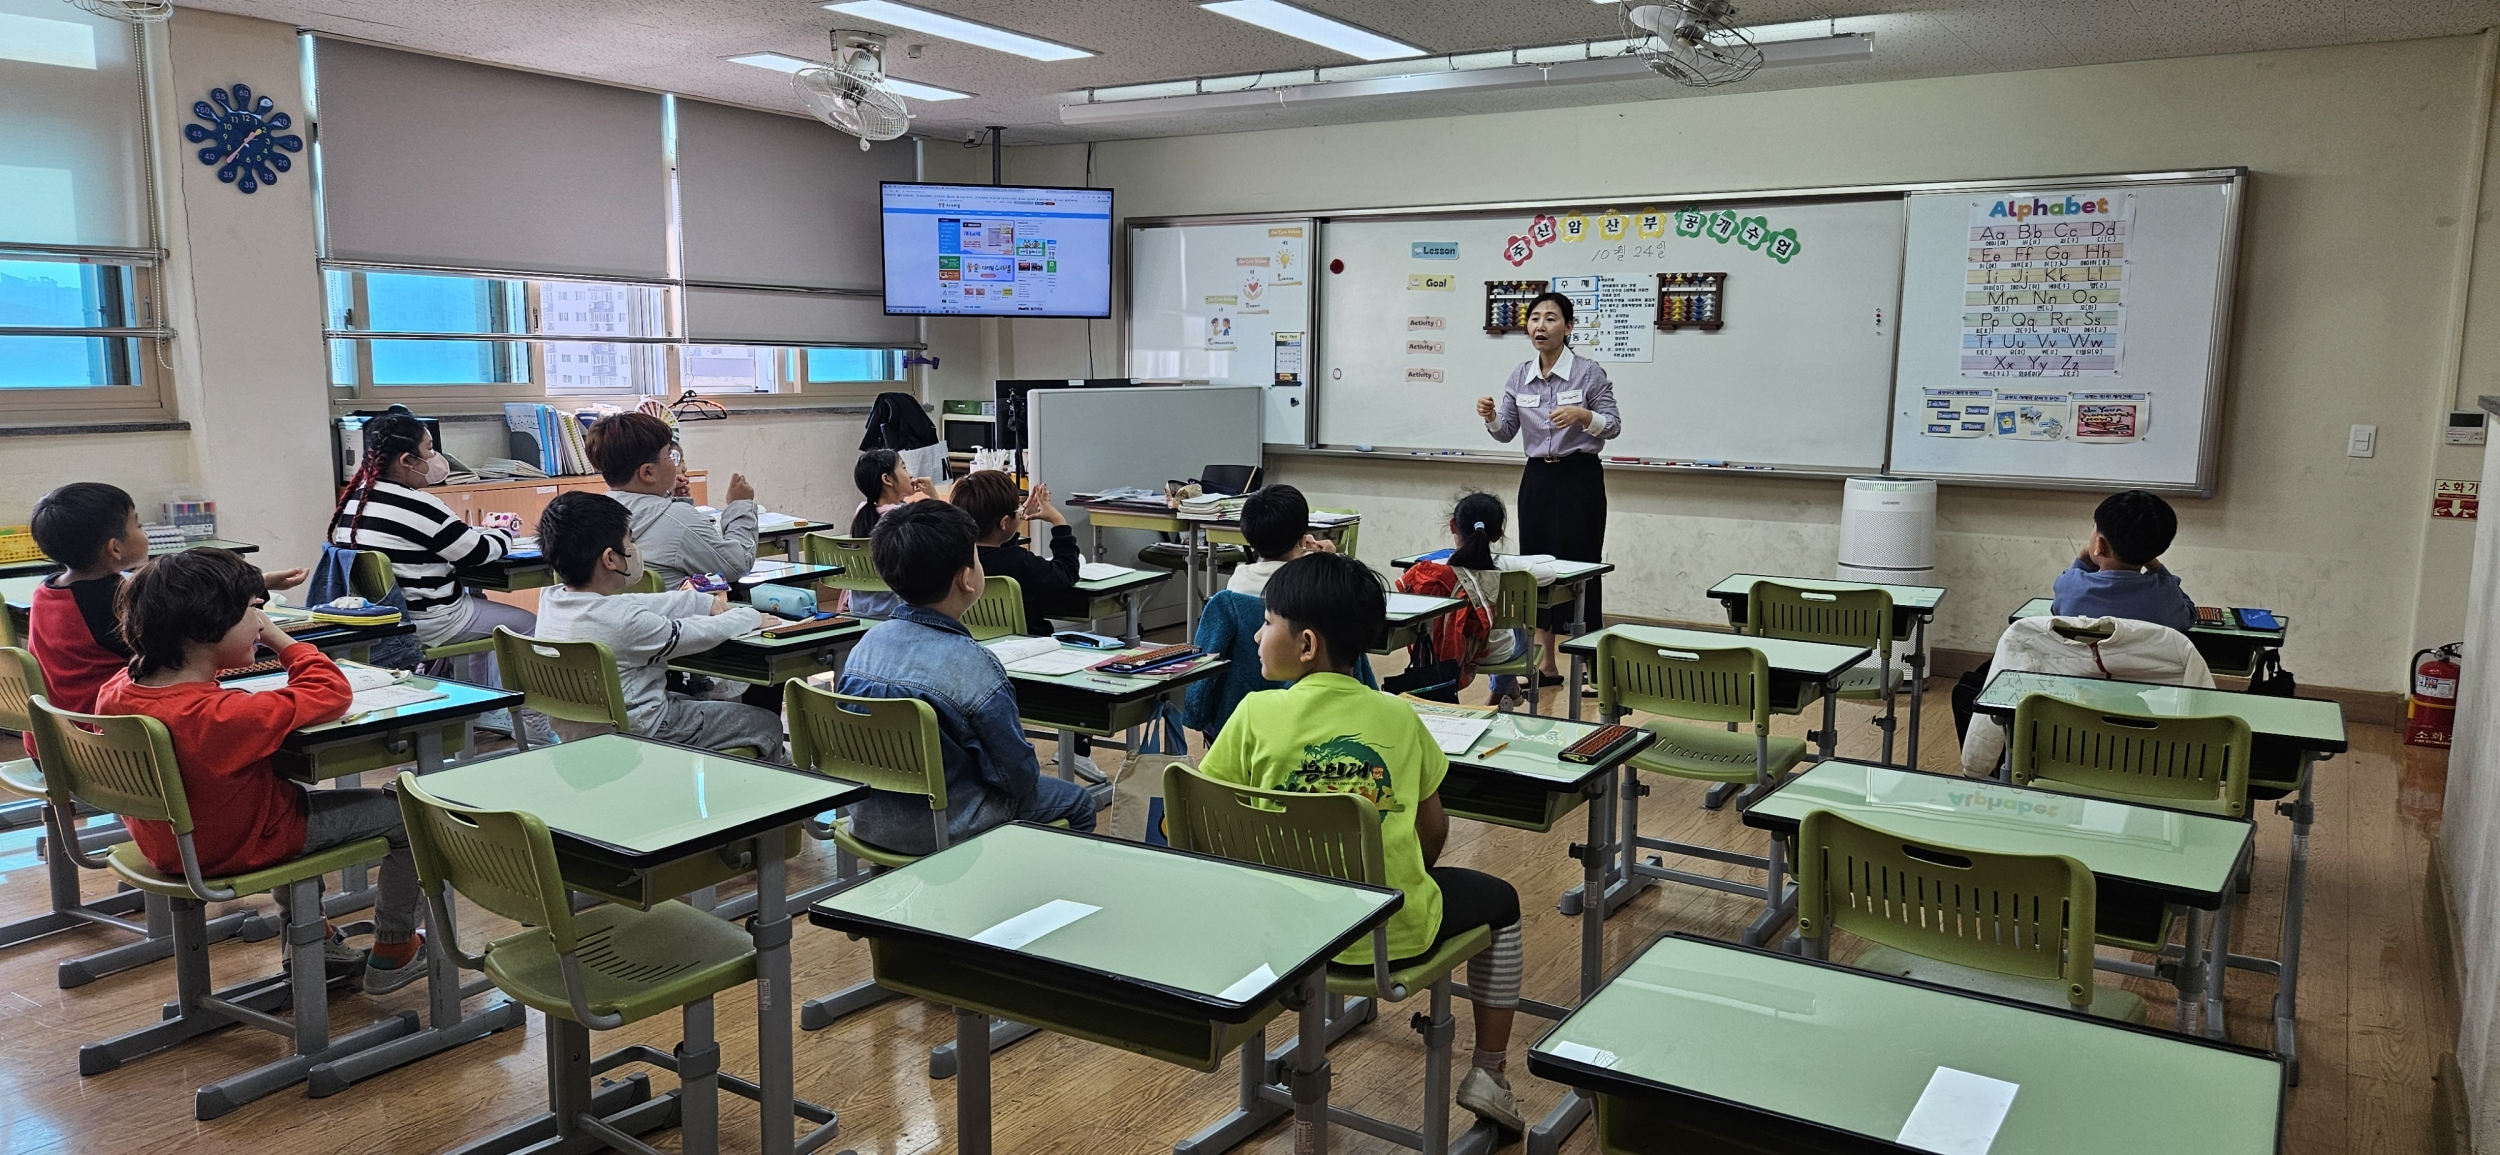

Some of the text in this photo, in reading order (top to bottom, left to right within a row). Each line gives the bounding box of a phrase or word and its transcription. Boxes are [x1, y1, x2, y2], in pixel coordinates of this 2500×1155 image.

[1989, 197, 2109, 222] Alphabet
[1980, 221, 2116, 240] Aa Bb Cc Dd
[1423, 247, 1455, 255] Lesson
[1982, 244, 2110, 266] Ee Ff Gg Hh
[1426, 279, 1446, 288] Goal
[1986, 267, 2103, 289] Ii Jj Kk Ll
[1988, 289, 2098, 305] Mm Nn Oo
[1981, 311, 2101, 333] Pp Qq Rr Ss
[1976, 334, 2103, 348] Tt Uu Vv Ww
[1993, 355, 2079, 376] Xx Yy Zz
[2438, 482, 2479, 494] 소화기
[1295, 760, 1370, 783] 용인대
